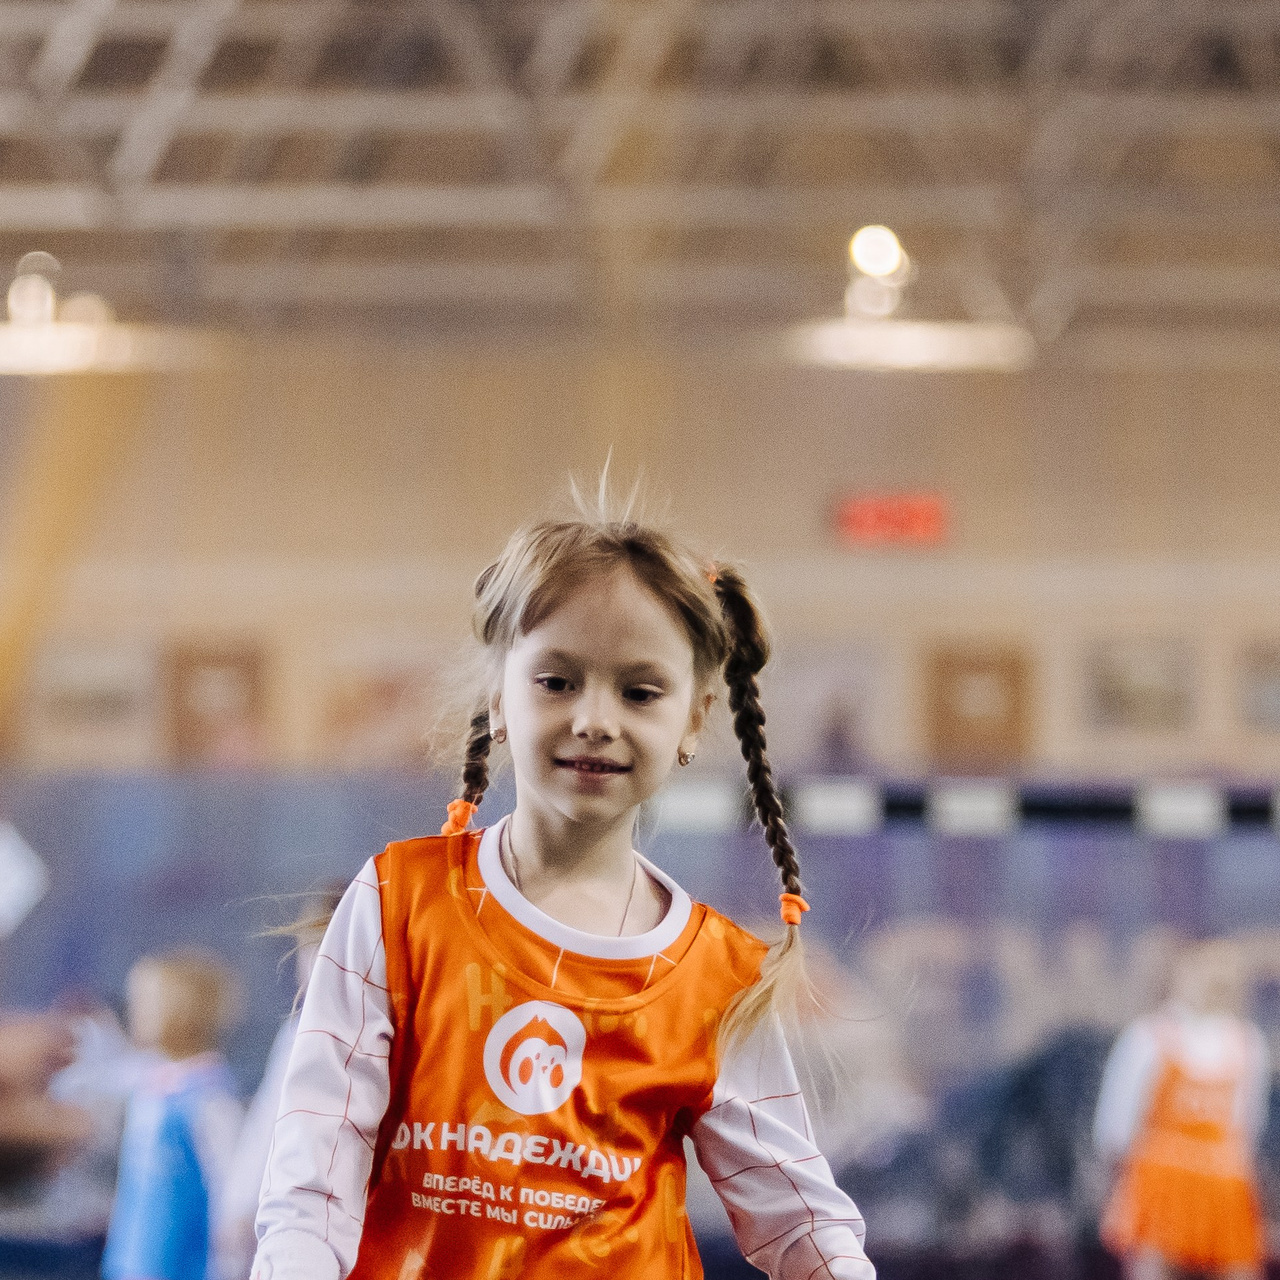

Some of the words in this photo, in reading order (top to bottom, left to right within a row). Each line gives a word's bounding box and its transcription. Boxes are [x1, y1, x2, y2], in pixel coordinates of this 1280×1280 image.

[422, 1172, 496, 1202] ВПЕРЁД
[499, 1184, 514, 1202] К
[410, 1191, 482, 1217] ВМЕСТЕ
[485, 1203, 518, 1225] МЫ
